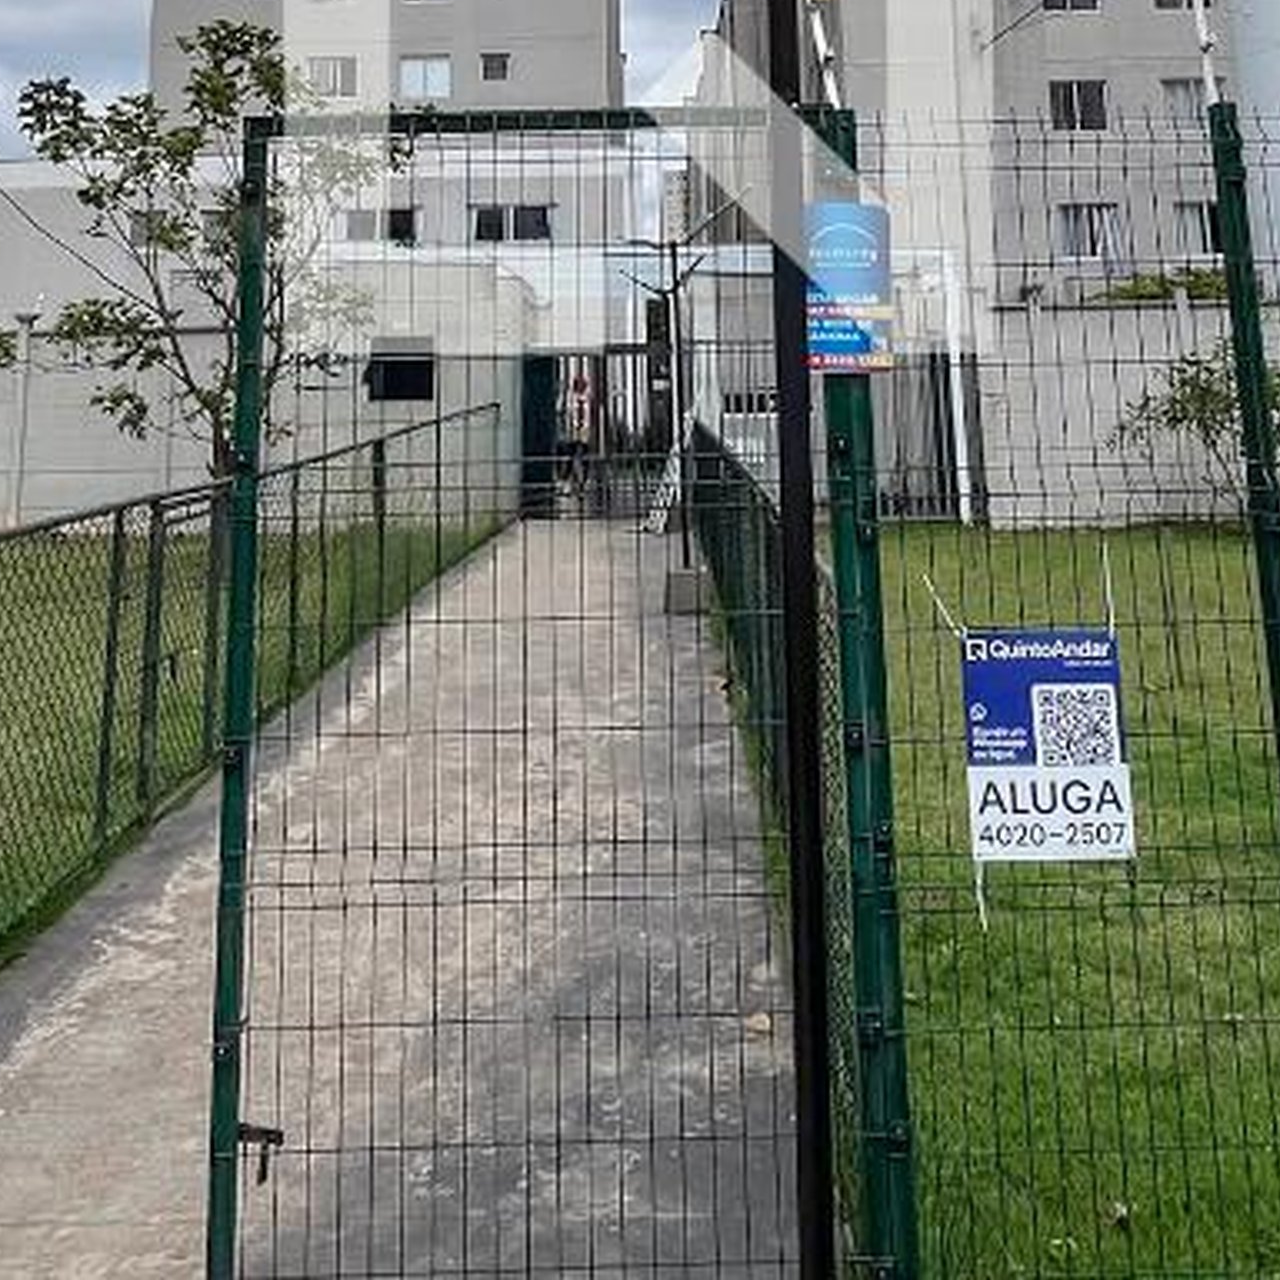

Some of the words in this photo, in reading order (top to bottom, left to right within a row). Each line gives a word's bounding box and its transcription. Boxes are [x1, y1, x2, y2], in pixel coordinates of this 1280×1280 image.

[989, 639, 1111, 660] QuintoAndar
[978, 779, 1124, 815] ALUGA
[978, 822, 1126, 847] 4020-2507
